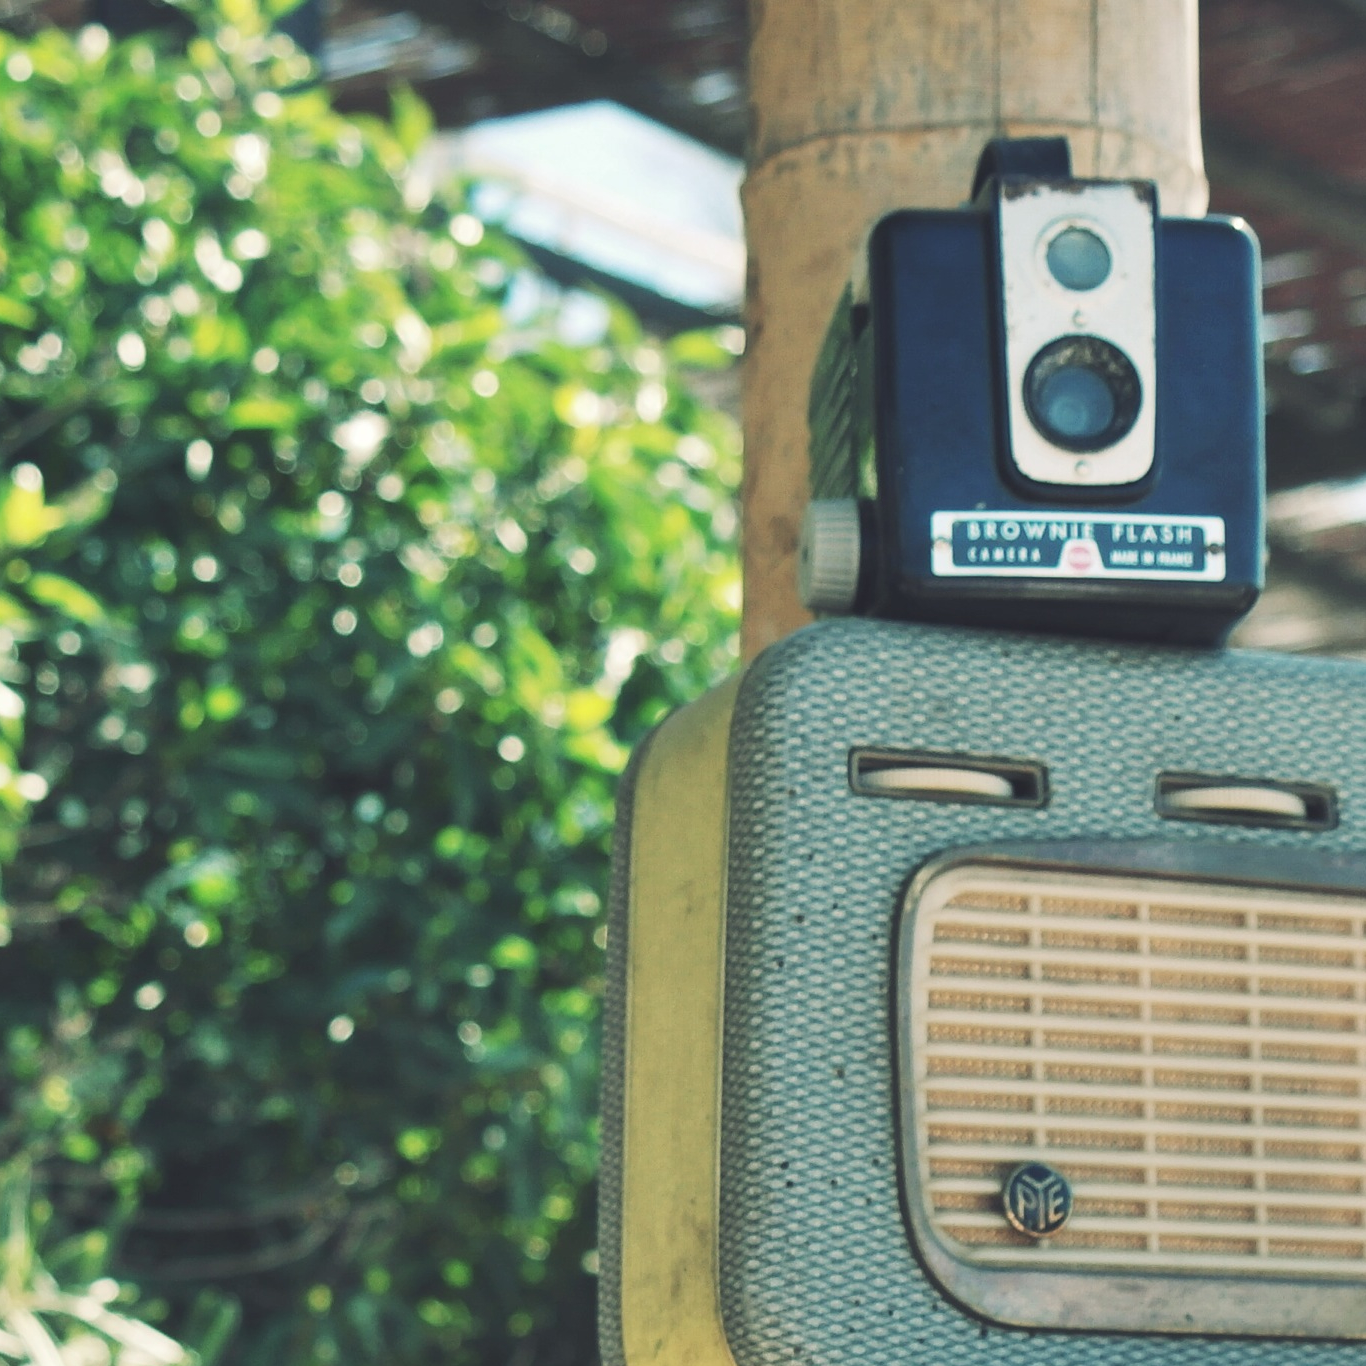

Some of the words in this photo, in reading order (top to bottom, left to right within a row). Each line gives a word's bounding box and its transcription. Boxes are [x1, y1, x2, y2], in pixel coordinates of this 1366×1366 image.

[966, 521, 1094, 541] BROWNIE
[1111, 524, 1194, 544] FLASH
[967, 546, 1042, 563] CAMERA
[1016, 1173, 1065, 1231] PYE
